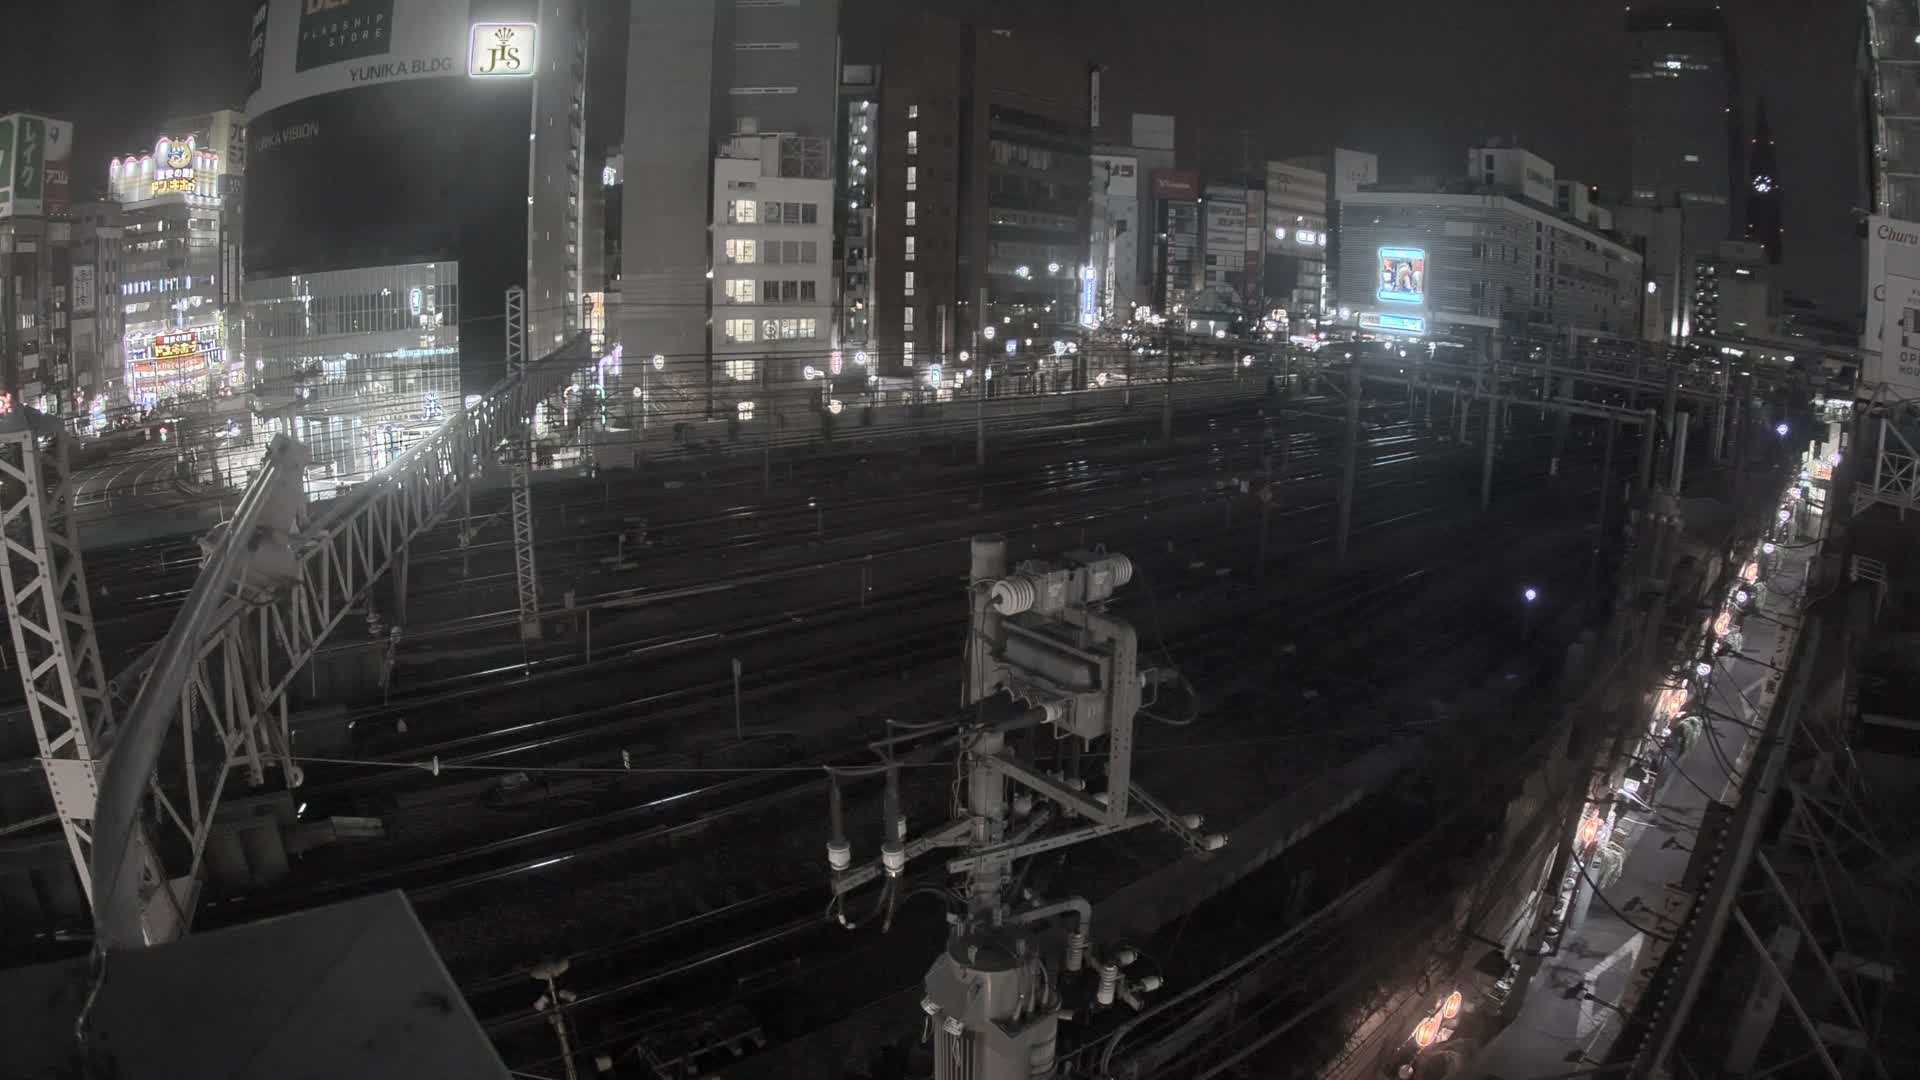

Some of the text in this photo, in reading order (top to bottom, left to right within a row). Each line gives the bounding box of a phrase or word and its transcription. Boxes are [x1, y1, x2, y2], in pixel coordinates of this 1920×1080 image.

[303, 13, 385, 41] FLAGSHIP
[327, 28, 384, 48] STORE
[349, 57, 453, 82] YUNIKA BLDG
